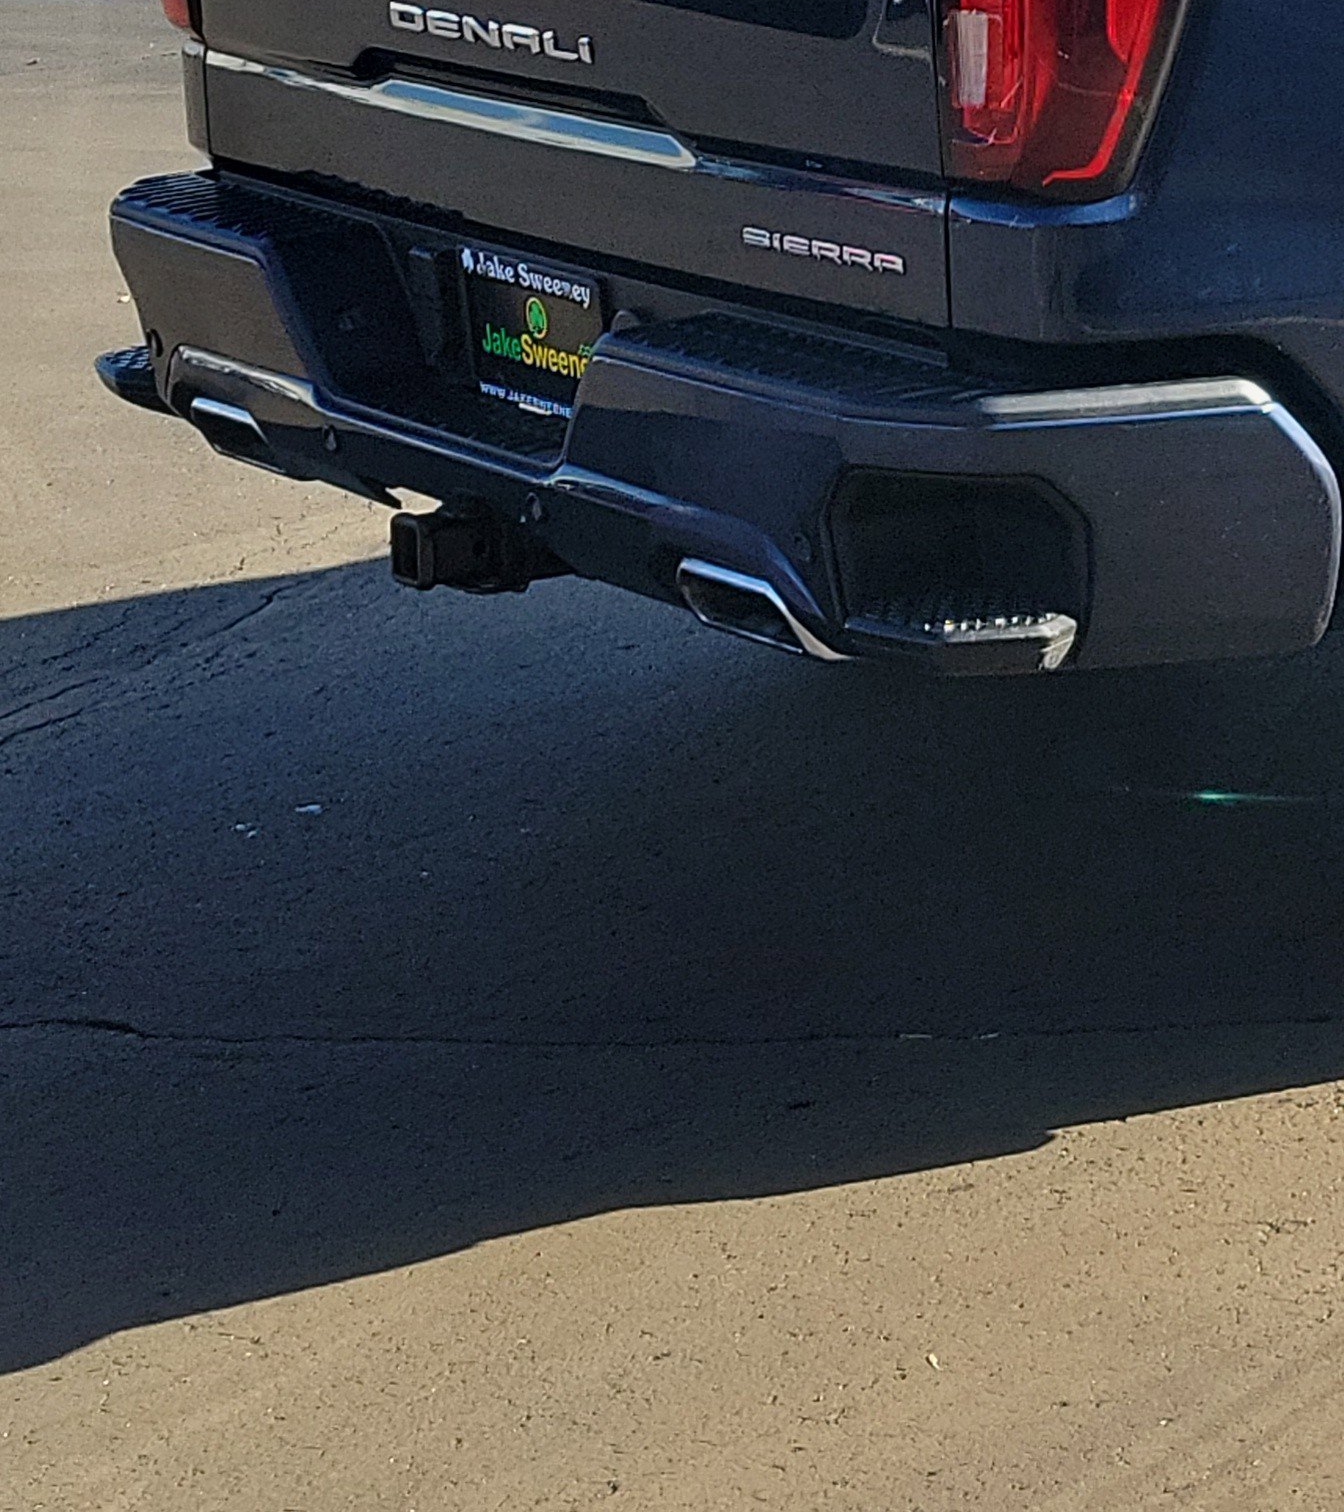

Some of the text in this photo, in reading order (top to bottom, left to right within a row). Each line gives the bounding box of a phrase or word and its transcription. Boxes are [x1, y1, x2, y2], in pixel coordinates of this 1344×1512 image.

[388, 0, 595, 65] DENALI
[476, 251, 516, 284] Jake
[741, 226, 906, 275] SIERRA
